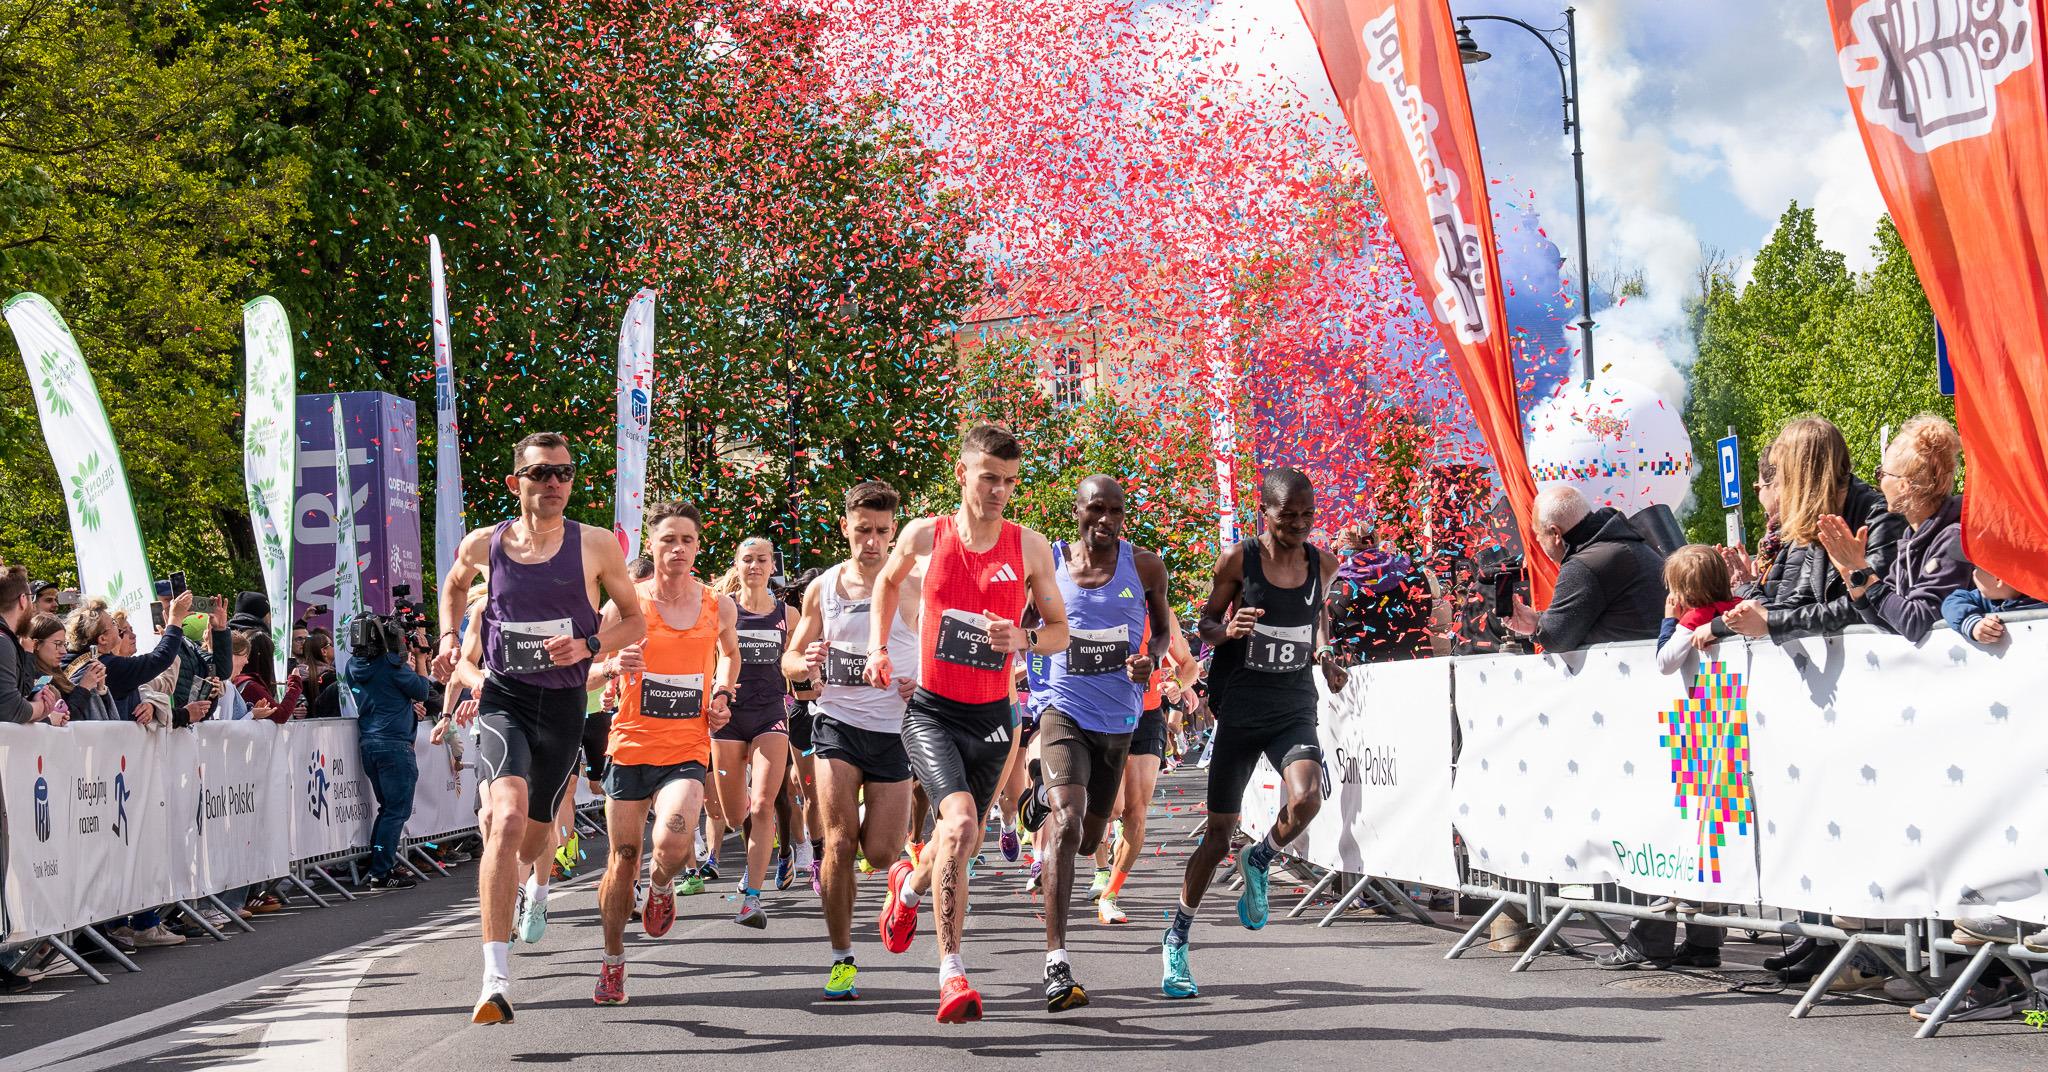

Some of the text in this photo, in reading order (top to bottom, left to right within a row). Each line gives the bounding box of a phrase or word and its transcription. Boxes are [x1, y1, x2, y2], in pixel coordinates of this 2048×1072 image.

[1721, 445, 1735, 499] P
[957, 630, 991, 644] KACZO
[516, 640, 543, 650] NOWI
[969, 642, 978, 654] 3
[1080, 644, 1116, 654] KIMAIYO
[533, 649, 542, 660] 4
[754, 648, 761, 656] 5
[1265, 642, 1295, 663] 18
[1094, 654, 1103, 664] 9
[847, 666, 861, 676] 16
[649, 689, 696, 698] KOZŁOWSKI
[669, 699, 677, 708] 7
[1335, 741, 1397, 786] Bank Polski
[77, 776, 107, 807] Biegajmy
[205, 783, 256, 820] Bank Polski
[79, 814, 100, 835] razem
[1612, 840, 1695, 881] Podlaskie
